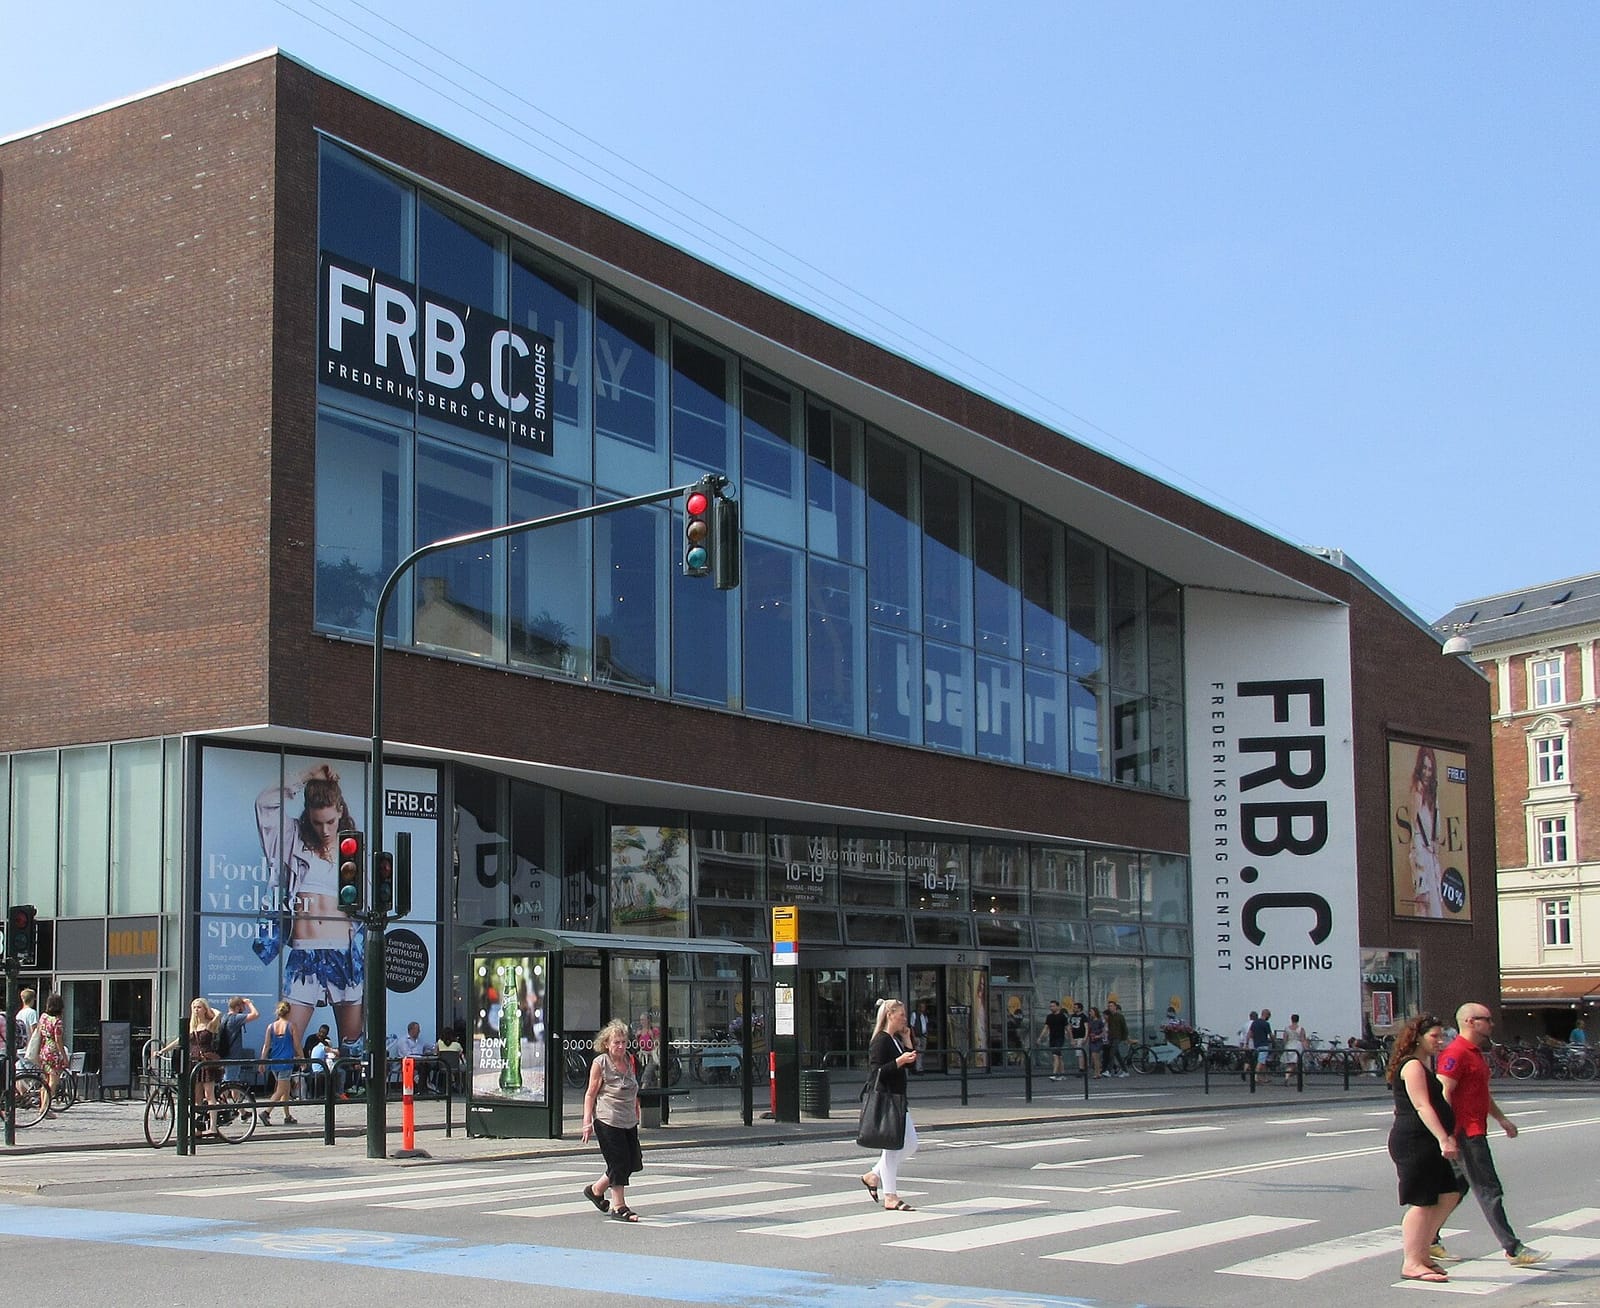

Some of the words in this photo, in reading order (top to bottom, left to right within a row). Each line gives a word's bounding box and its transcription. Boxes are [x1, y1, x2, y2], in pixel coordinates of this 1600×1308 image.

[329, 265, 530, 413] FRB.C
[534, 343, 546, 420] SHOPPING
[328, 361, 469, 417] FREDERIKSBERG
[478, 410, 546, 442] CENTRET
[1211, 682, 1229, 862] FREDERIKSBERG
[387, 792, 433, 812] FRB.C
[1237, 678, 1333, 946] FRB.C
[208, 853, 275, 882] Fordi
[808, 844, 873, 863] Velkommen
[888, 851, 936, 871] Shopping
[785, 863, 824, 882] 10-19
[923, 873, 957, 891] 10-17
[208, 884, 232, 910] vi
[238, 885, 313, 913] elsker
[1442, 881, 1464, 907] 70%
[207, 919, 277, 947] sport
[1215, 876, 1231, 970] CENTRET
[957, 953, 966, 962] 21
[1244, 954, 1333, 971] SHOPPING
[385, 972, 417, 983] NTERSPORT
[1362, 973, 1396, 984] FONA
[480, 1037, 507, 1048] BORN
[480, 1048, 493, 1058] TO
[480, 1058, 509, 1069] RFRSH
